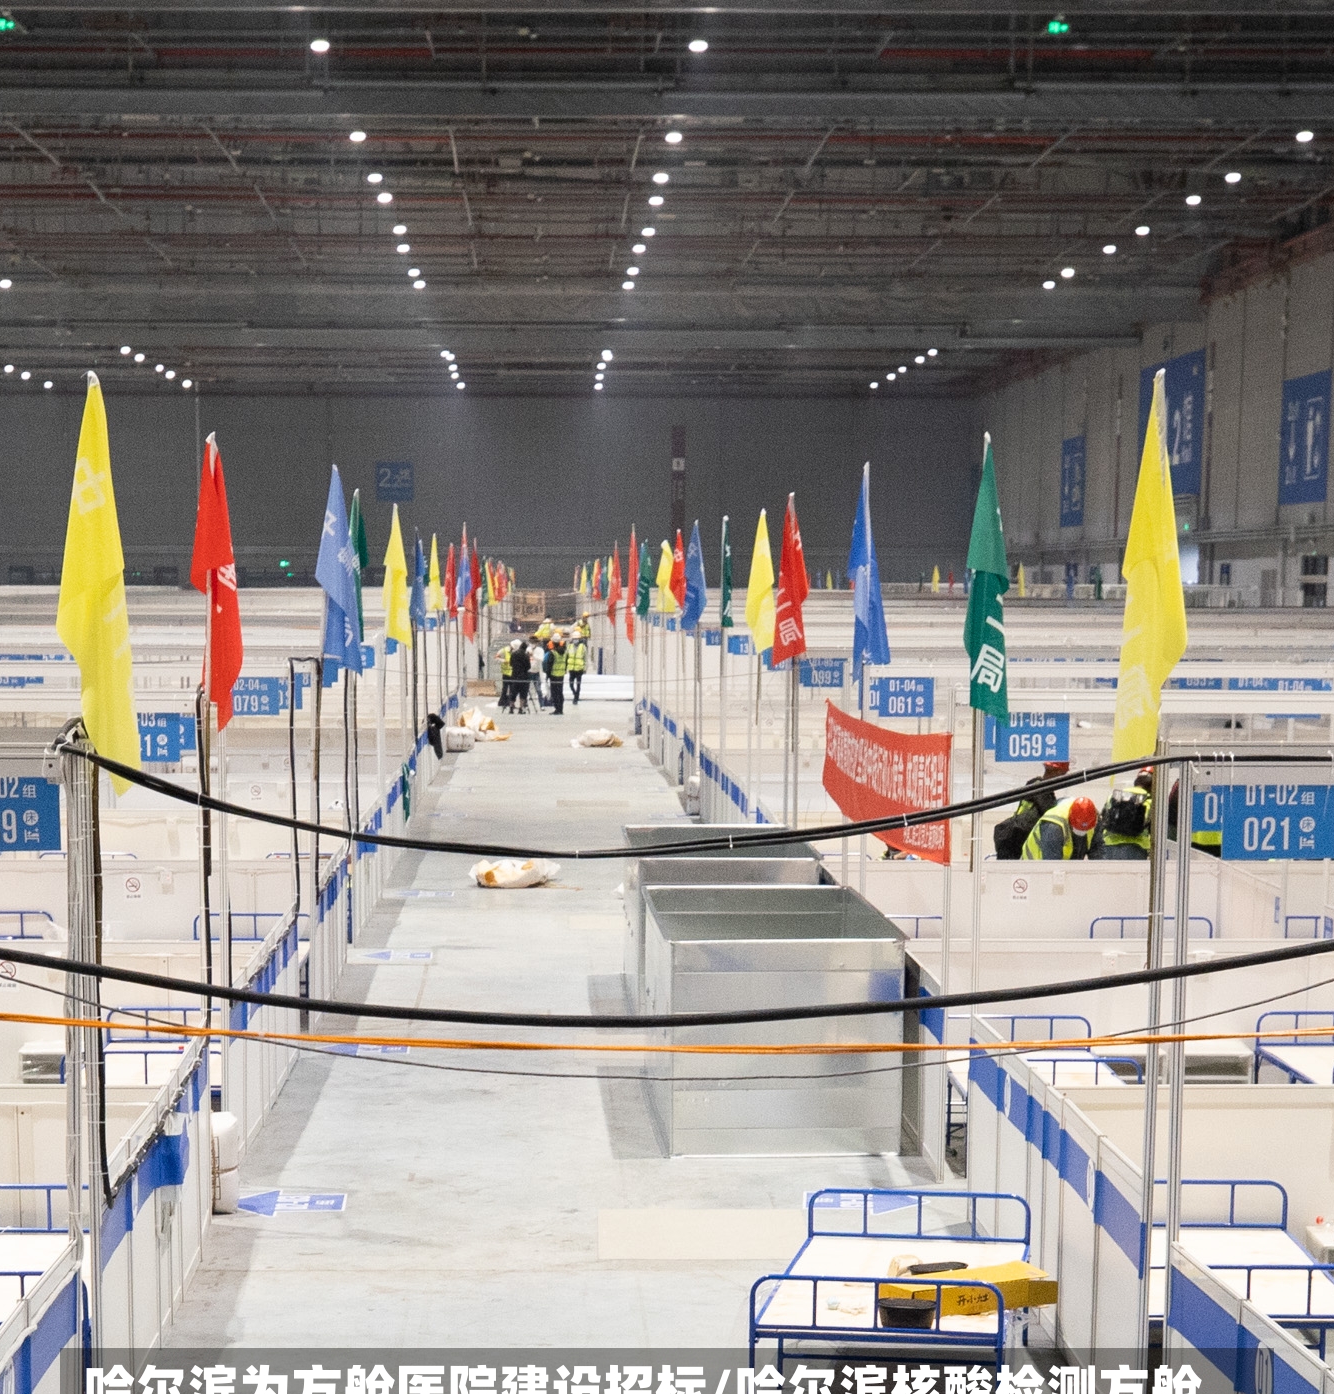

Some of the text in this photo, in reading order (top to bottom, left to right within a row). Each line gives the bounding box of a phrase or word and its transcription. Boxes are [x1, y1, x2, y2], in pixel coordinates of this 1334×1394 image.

[234, 695, 259, 712] 079
[889, 696, 912, 714] 061
[1009, 734, 1043, 757] 059
[1245, 785, 1299, 806] D1-02
[1243, 817, 1290, 851] 021
